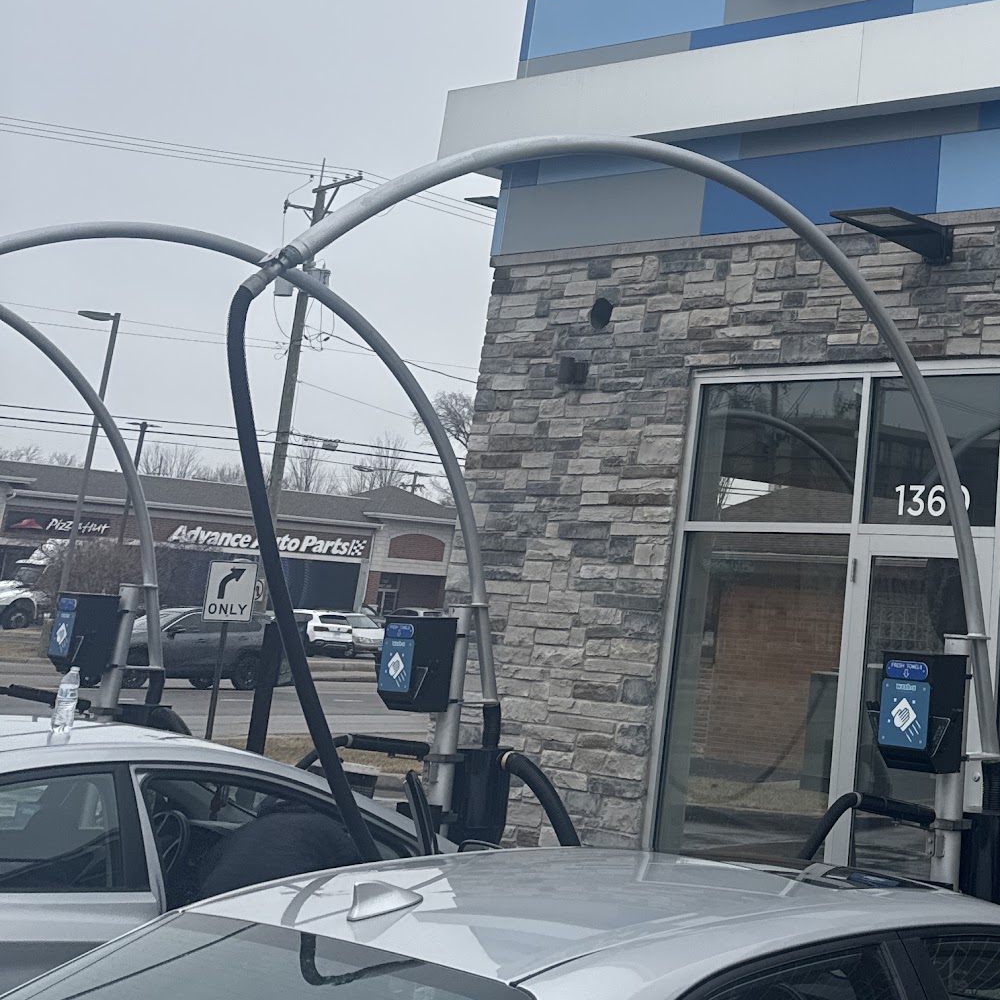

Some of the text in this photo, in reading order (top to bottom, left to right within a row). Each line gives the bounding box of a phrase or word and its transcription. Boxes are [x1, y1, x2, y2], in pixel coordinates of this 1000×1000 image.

[168, 525, 351, 555] Advance to Parts
[208, 603, 248, 616] ONLY
